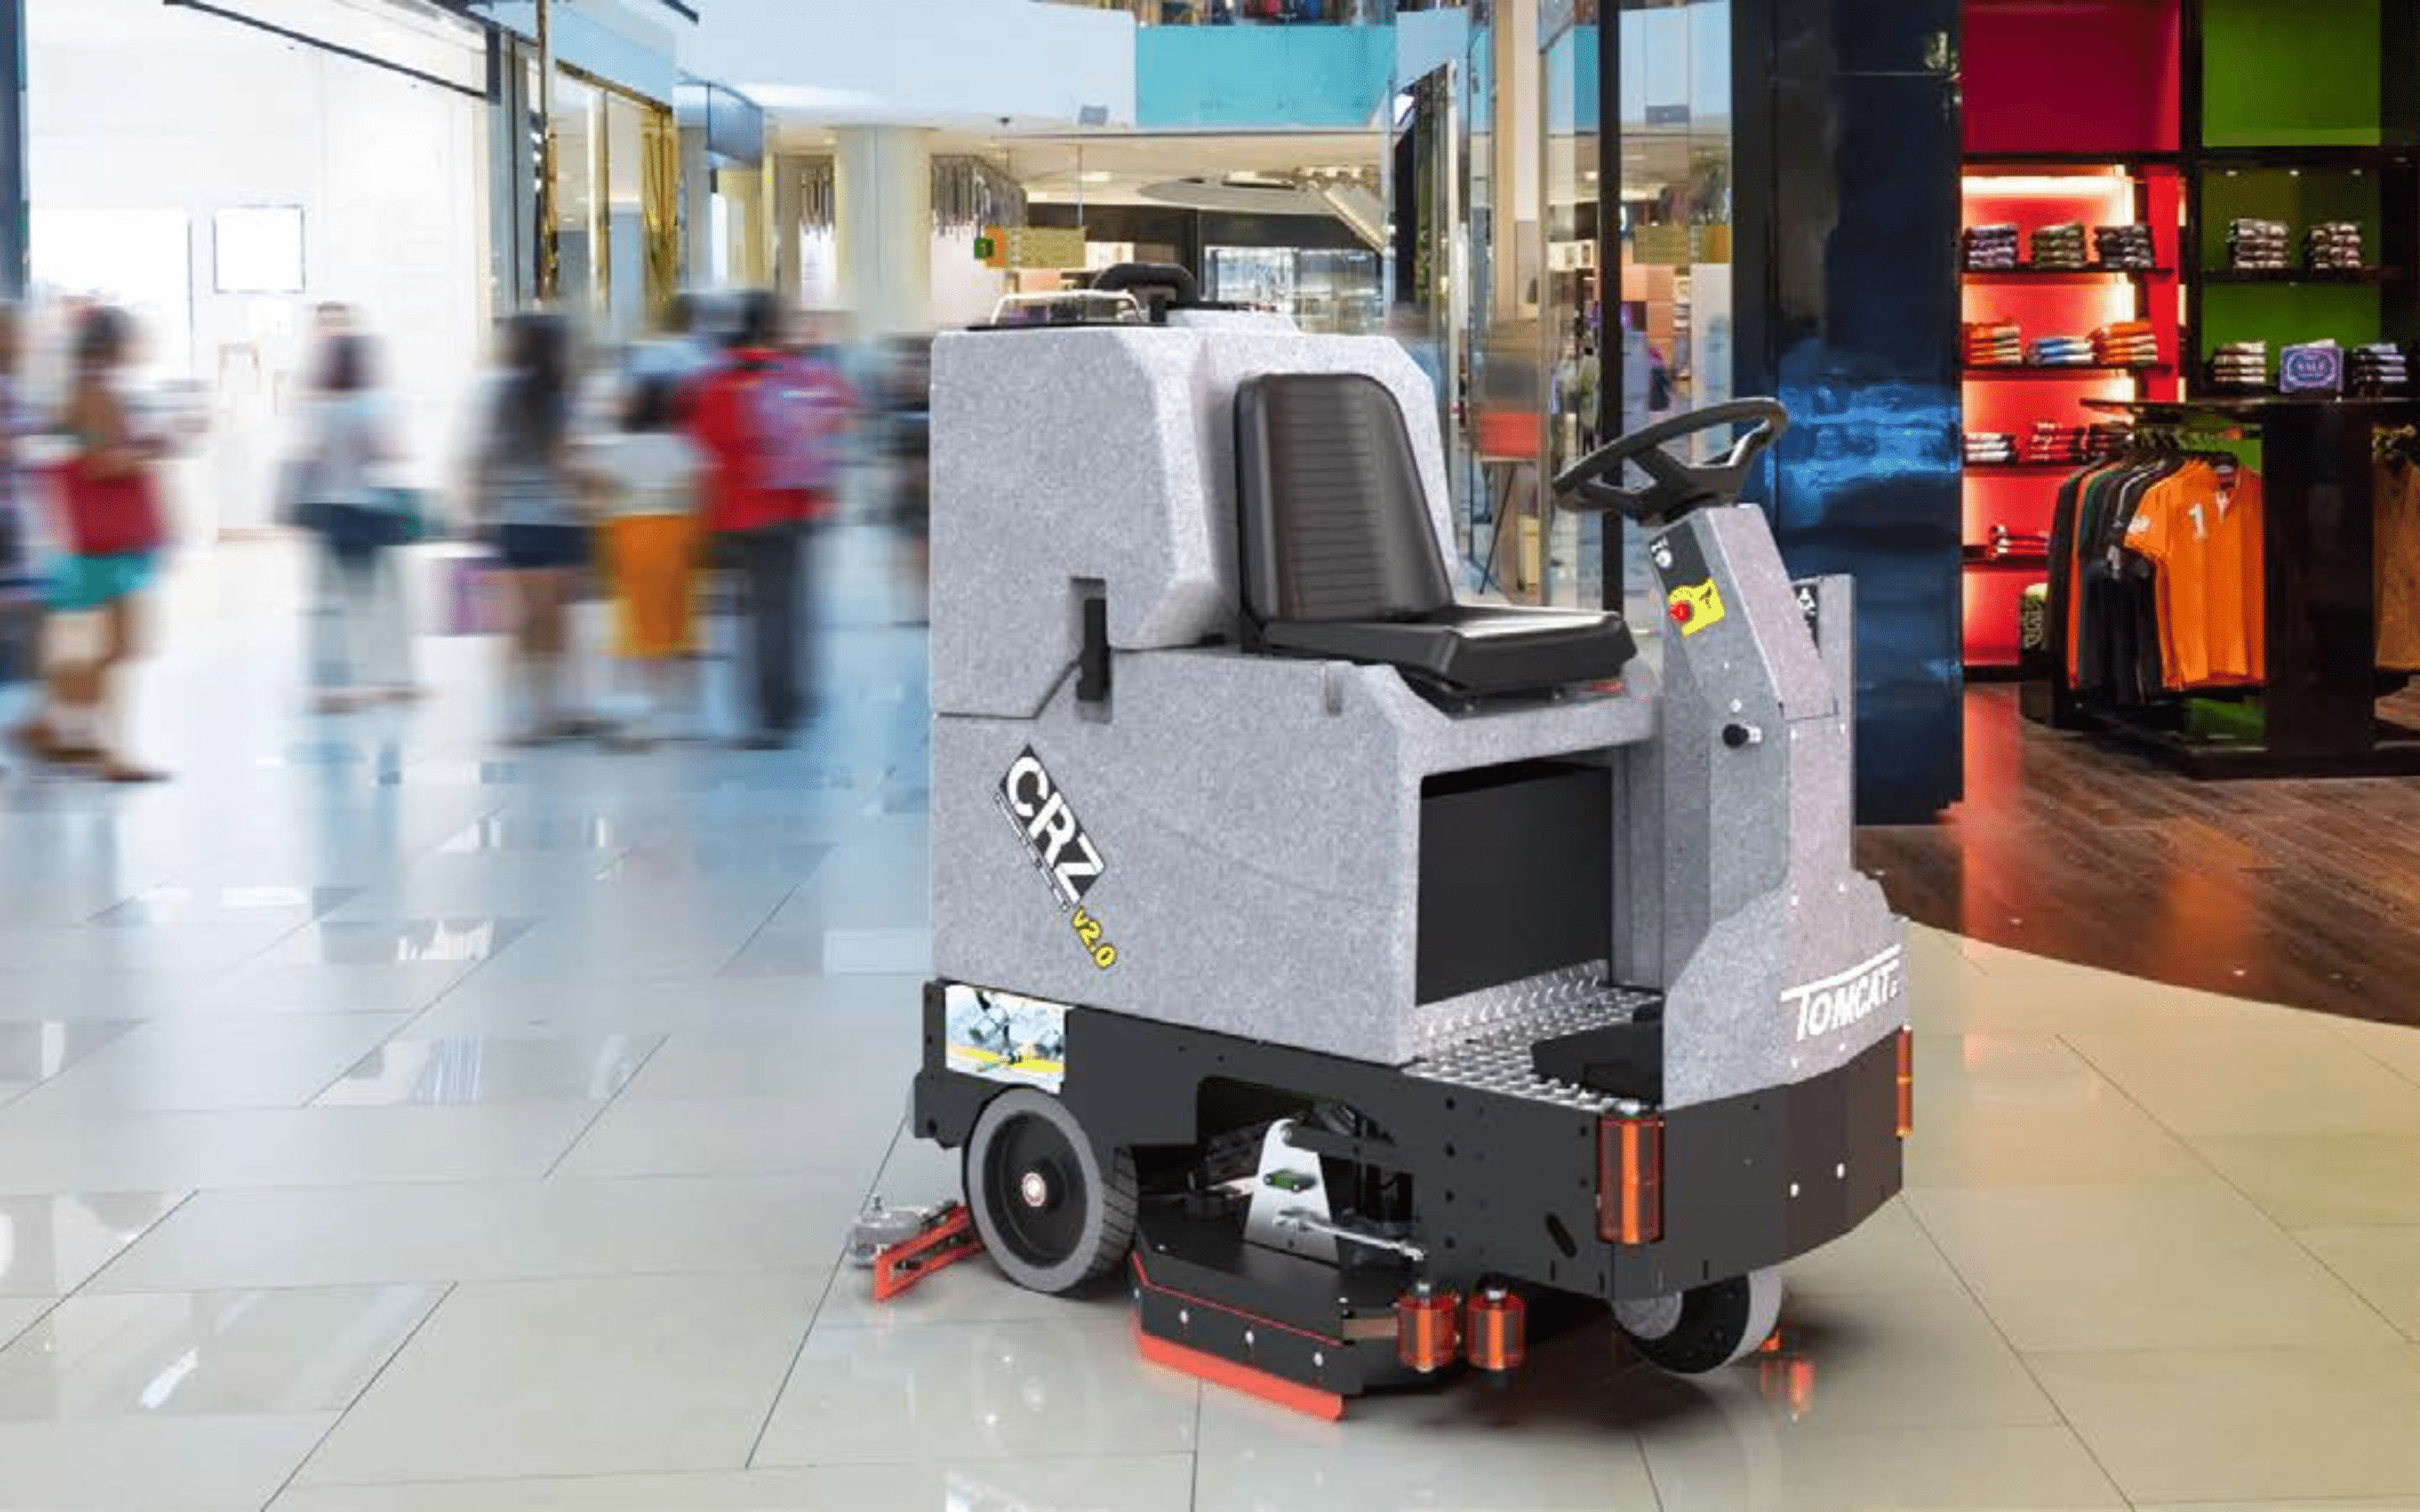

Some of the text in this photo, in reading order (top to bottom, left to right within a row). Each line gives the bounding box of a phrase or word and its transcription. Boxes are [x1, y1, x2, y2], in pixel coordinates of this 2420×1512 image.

[2188, 502, 2208, 541] 1
[1007, 756, 1105, 903] CRZ
[1071, 906, 1118, 969] v2.0
[1781, 943, 1902, 1042] TOMCAT
